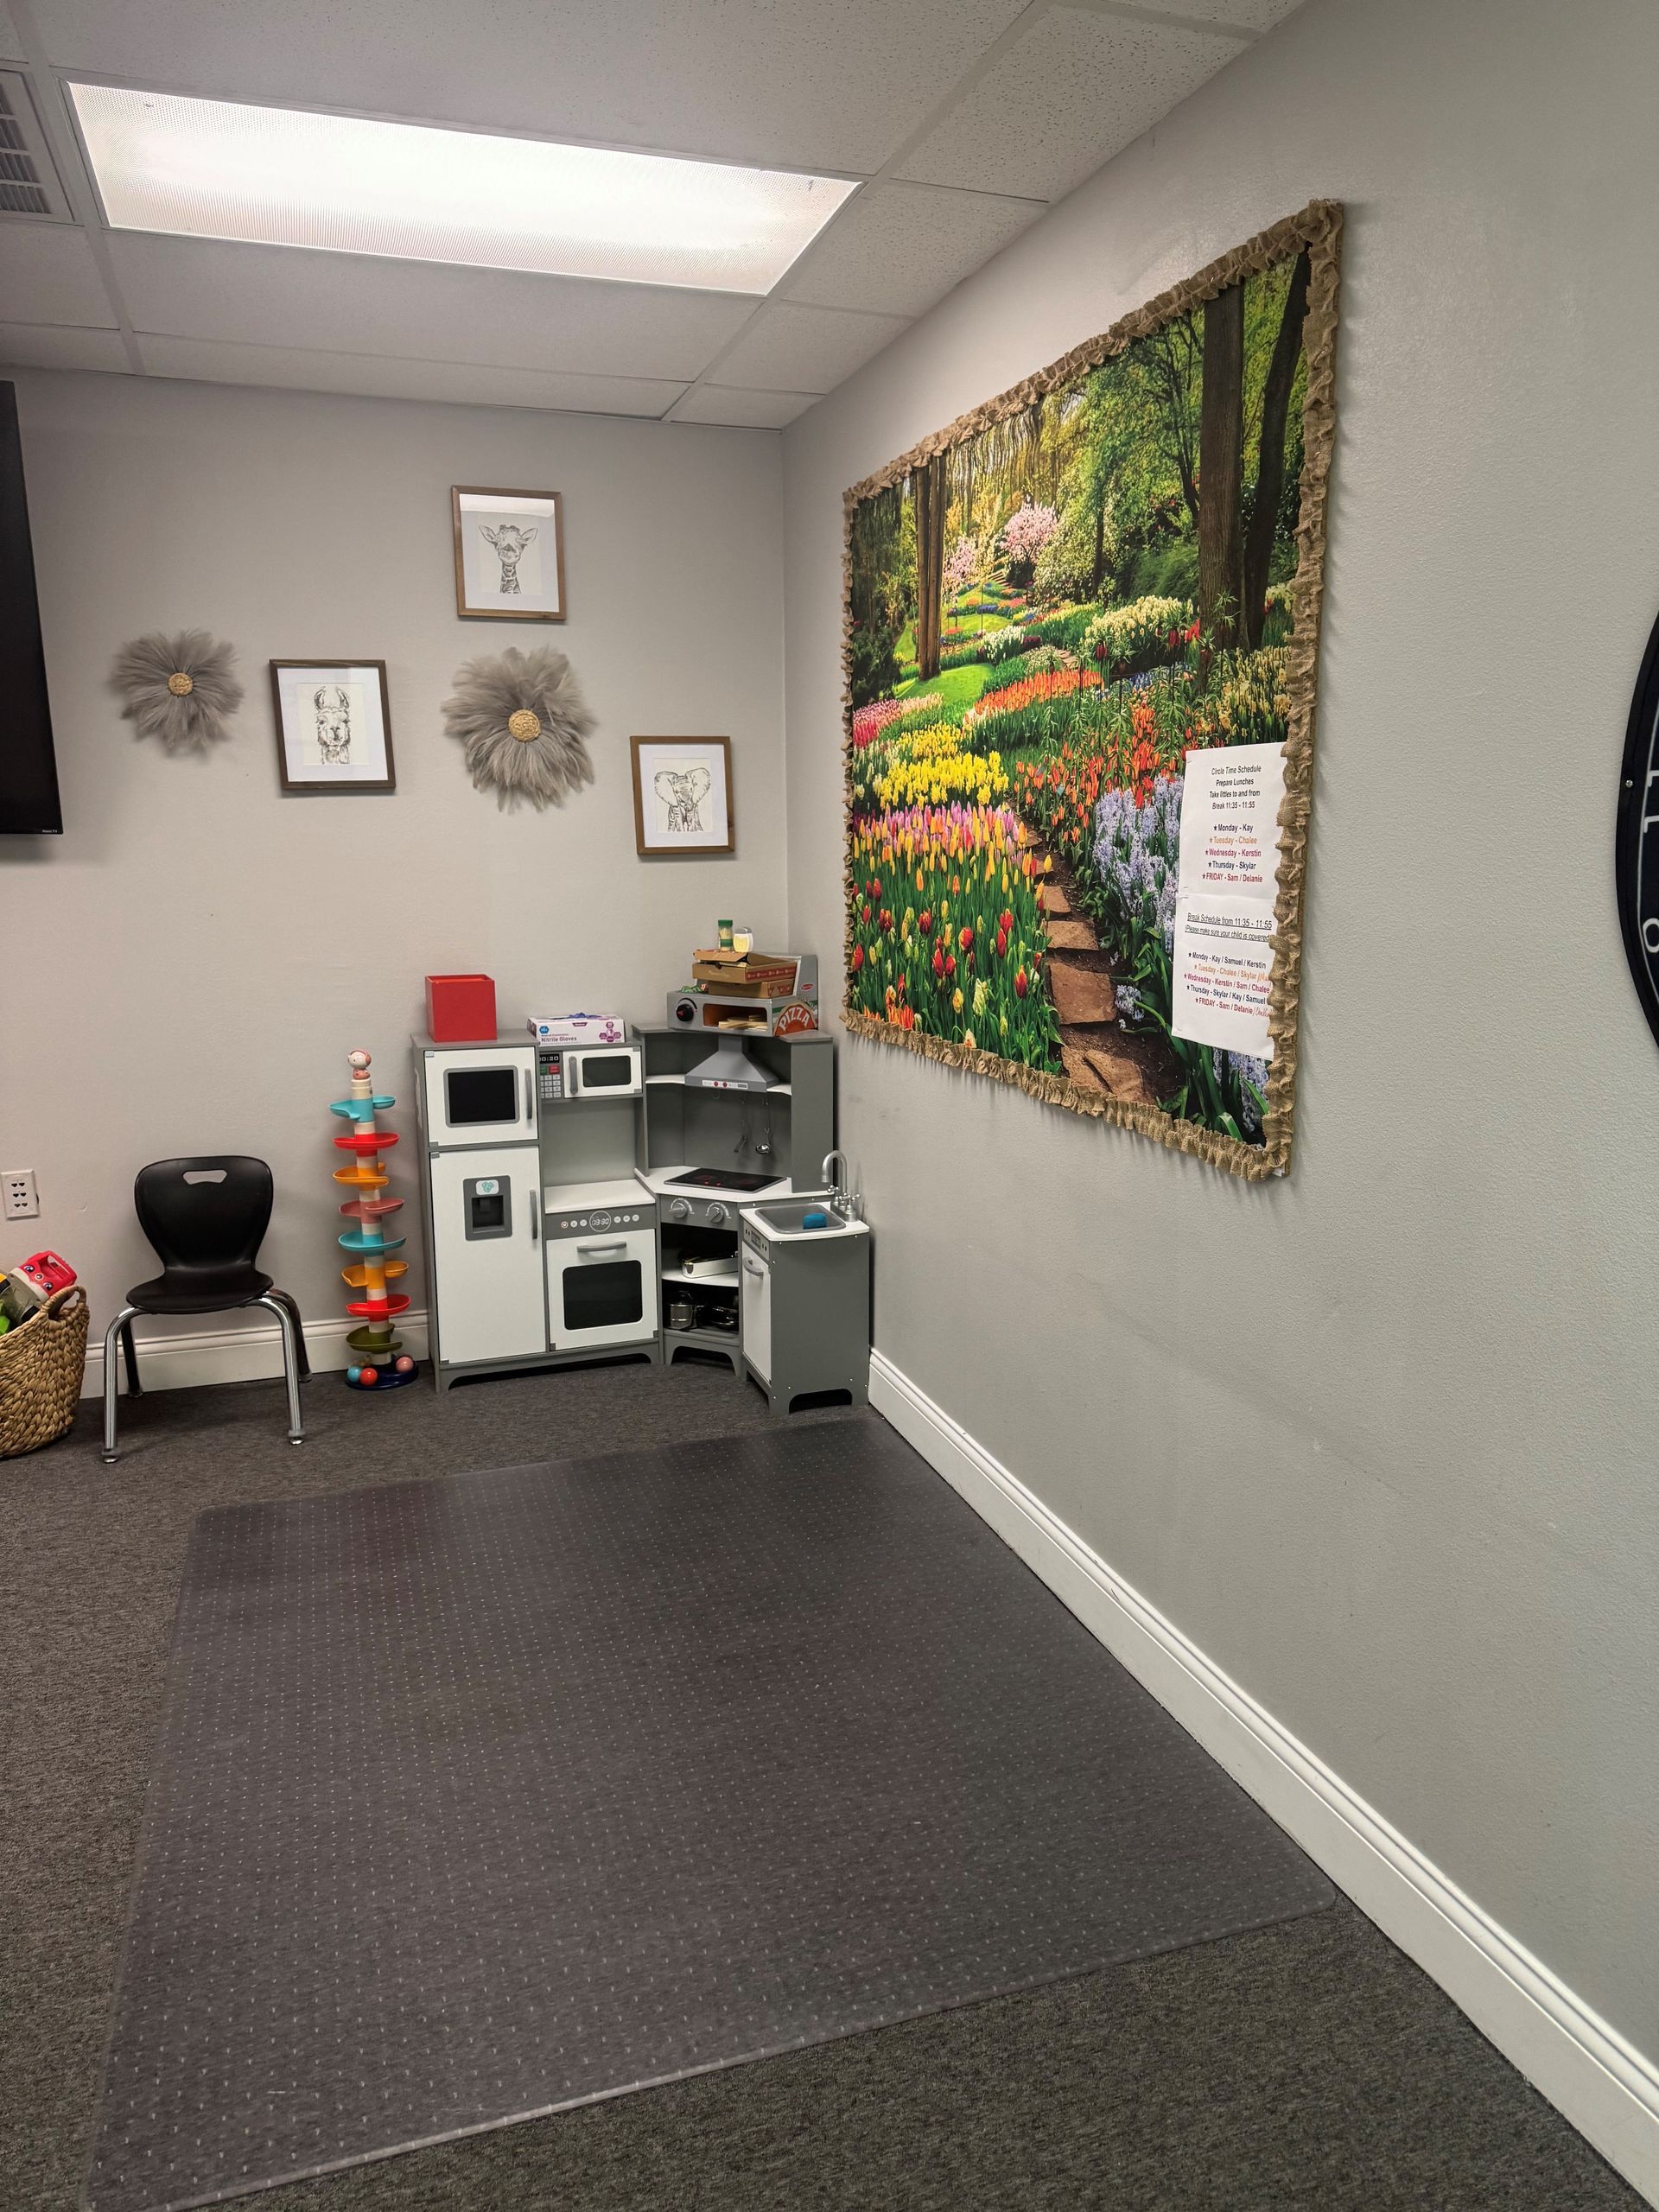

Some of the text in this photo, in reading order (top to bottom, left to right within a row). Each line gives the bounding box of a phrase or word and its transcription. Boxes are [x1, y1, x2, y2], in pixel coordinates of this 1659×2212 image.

[1218, 824, 1237, 833] Monday
[1243, 824, 1253, 833] Kay
[1214, 836, 1234, 845] Tuesday
[1209, 849, 1236, 858] Wednesday
[1212, 861, 1235, 870] Thursday
[1239, 861, 1256, 871] Skylar
[1243, 874, 1262, 883] Delanie
[1187, 912, 1200, 921] Break
[1201, 914, 1220, 924] Schedule
[1235, 918, 1249, 927] 11:35
[1256, 920, 1272, 929] 11:55
[1192, 952, 1208, 962] Monday
[1224, 957, 1243, 966] Samuel
[1247, 960, 1266, 969] Kerstin
[1198, 963, 1216, 975] Tuesday
[1220, 968, 1237, 976] Chalee
[1241, 970, 1257, 981] Skylar
[1187, 973, 1211, 985] Wednesday
[1215, 979, 1232, 988] Kerstin
[1252, 984, 1270, 994] Chalee
[1191, 985, 1210, 995] Thursday
[1213, 989, 1229, 999] Skylar
[1232, 992, 1243, 1002] Kay
[1246, 995, 1266, 1005] Samuel
[1199, 998, 1216, 1007] FRIDAY
[1219, 1001, 1230, 1010] Sam
[1234, 1004, 1253, 1014] Delanie
[779, 1007, 810, 1031] PIZZA
